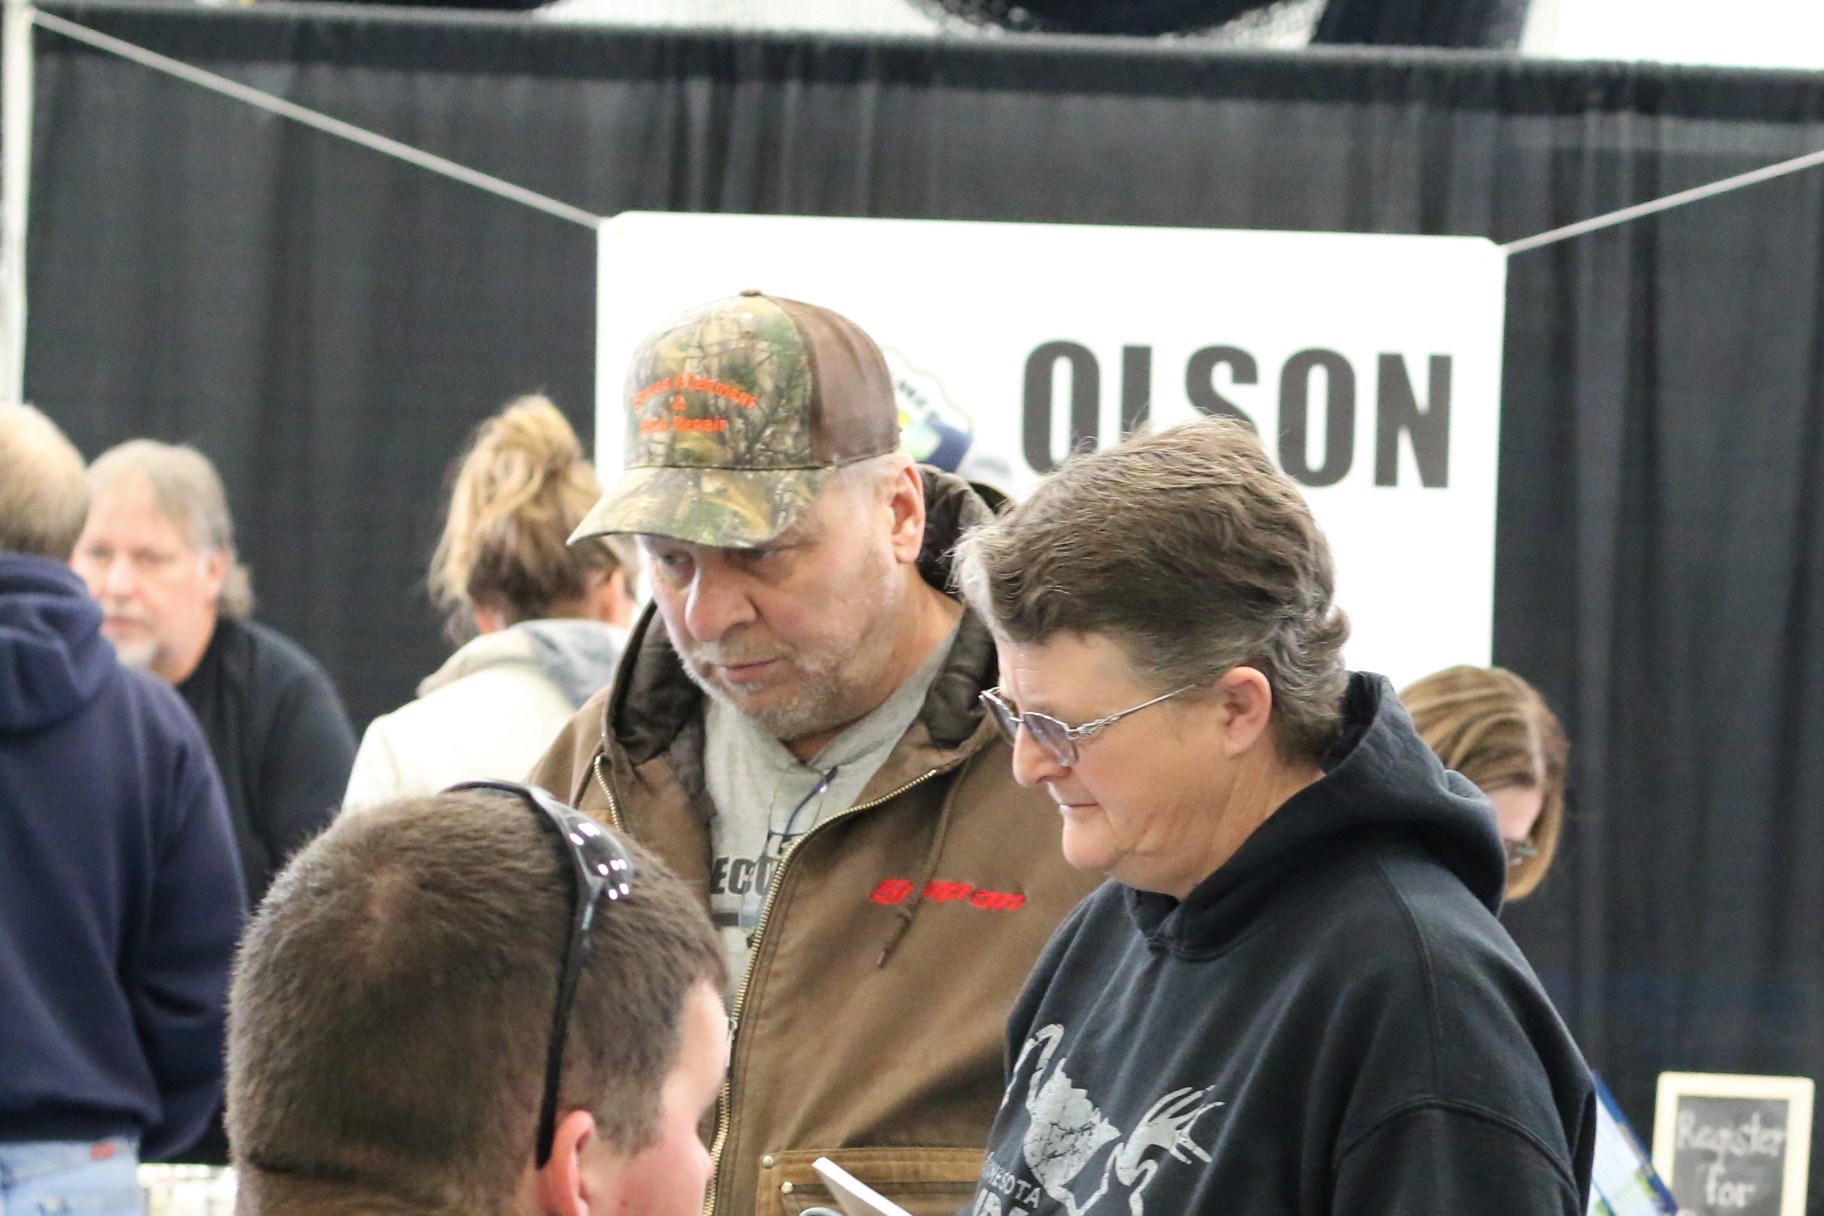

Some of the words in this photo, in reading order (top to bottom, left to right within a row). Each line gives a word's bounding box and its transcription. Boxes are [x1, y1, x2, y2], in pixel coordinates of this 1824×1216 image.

[1676, 1110, 1785, 1165] Register
[982, 1150, 1041, 1209] NESOTA
[1704, 1163, 1758, 1208] for
